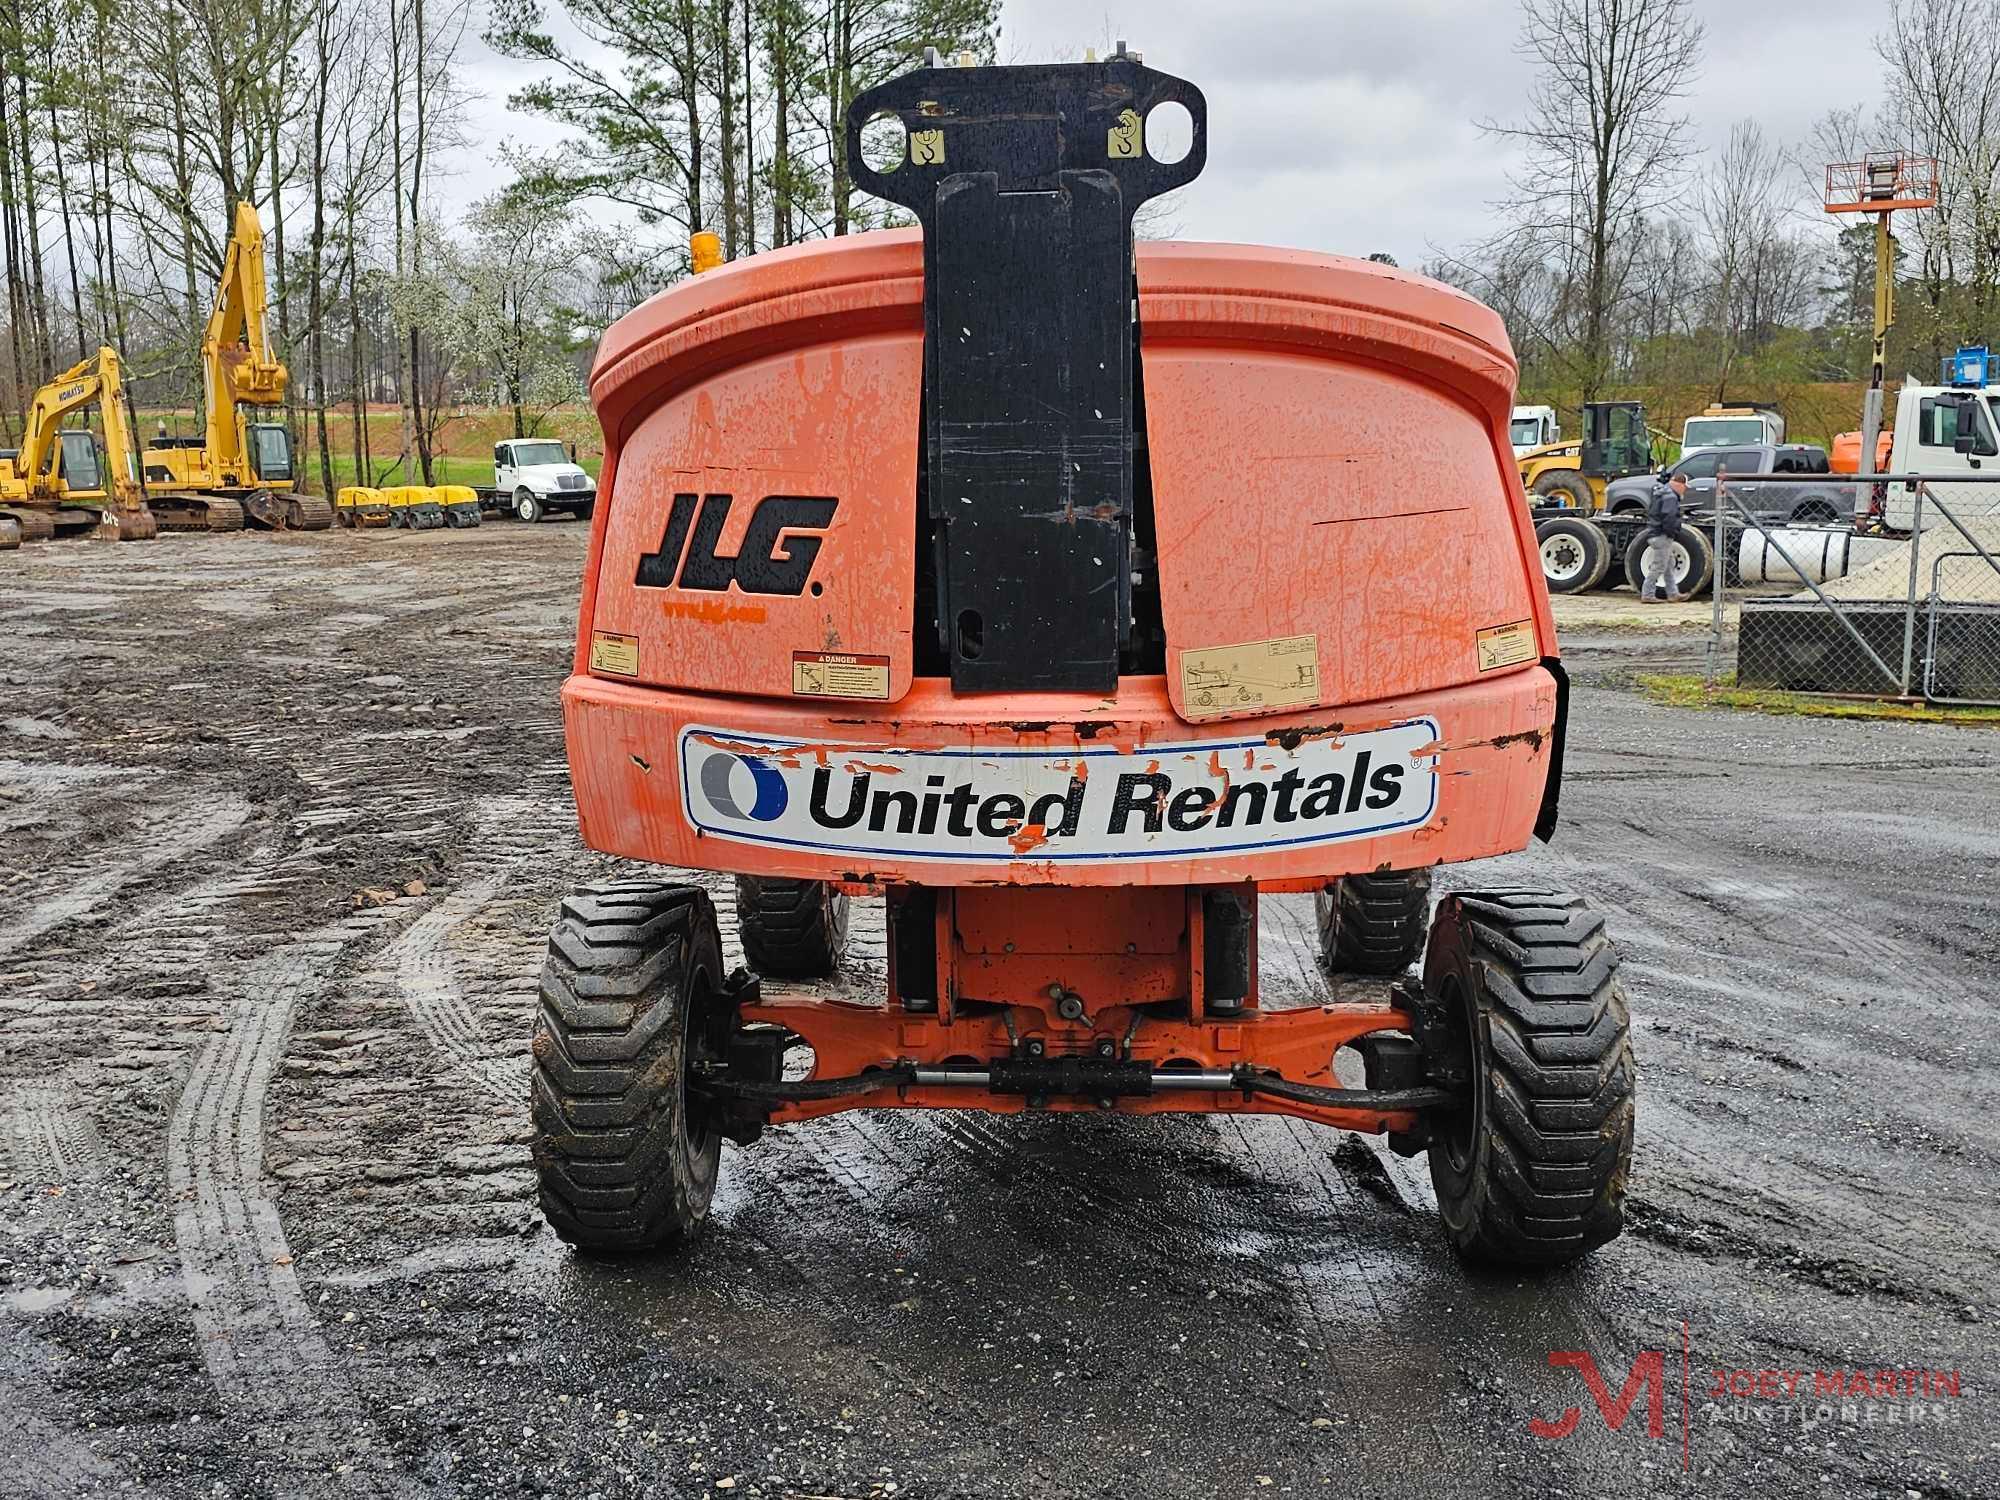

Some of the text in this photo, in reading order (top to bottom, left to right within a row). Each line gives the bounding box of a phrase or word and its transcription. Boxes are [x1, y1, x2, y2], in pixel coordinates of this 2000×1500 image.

[1565, 447, 1580, 457] CAT
[825, 656, 857, 664] DANGER
[809, 750, 1404, 838] United Rentals
